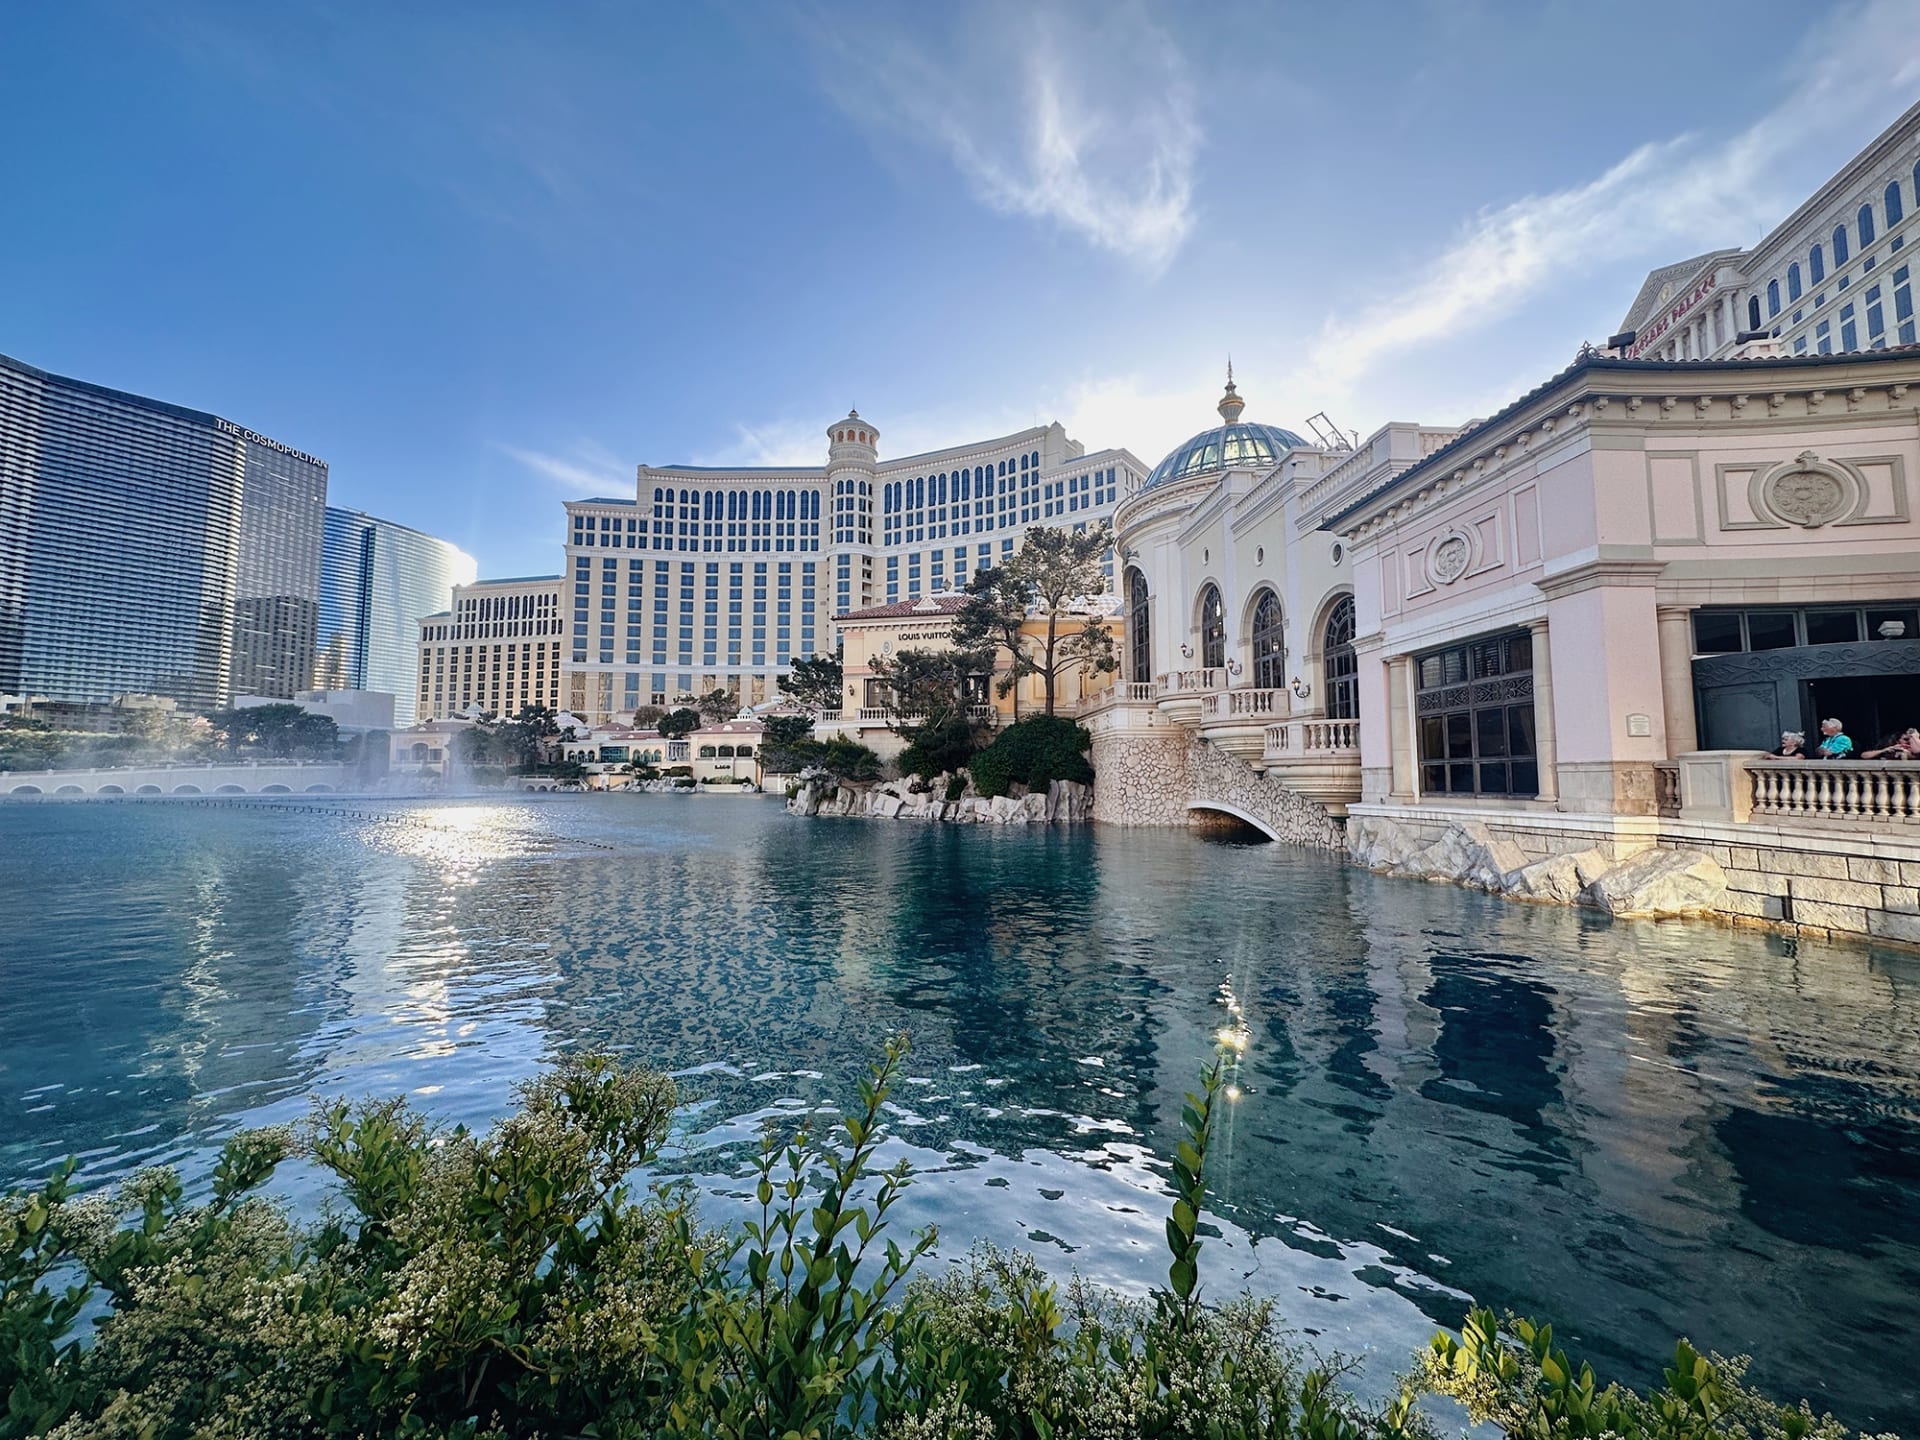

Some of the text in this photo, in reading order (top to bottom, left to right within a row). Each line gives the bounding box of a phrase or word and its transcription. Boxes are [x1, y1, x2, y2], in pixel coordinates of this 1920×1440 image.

[1671, 273, 1716, 323] PALACE
[216, 418, 327, 469] THE COSMOPOLITAN
[898, 633, 920, 641] LOUIS
